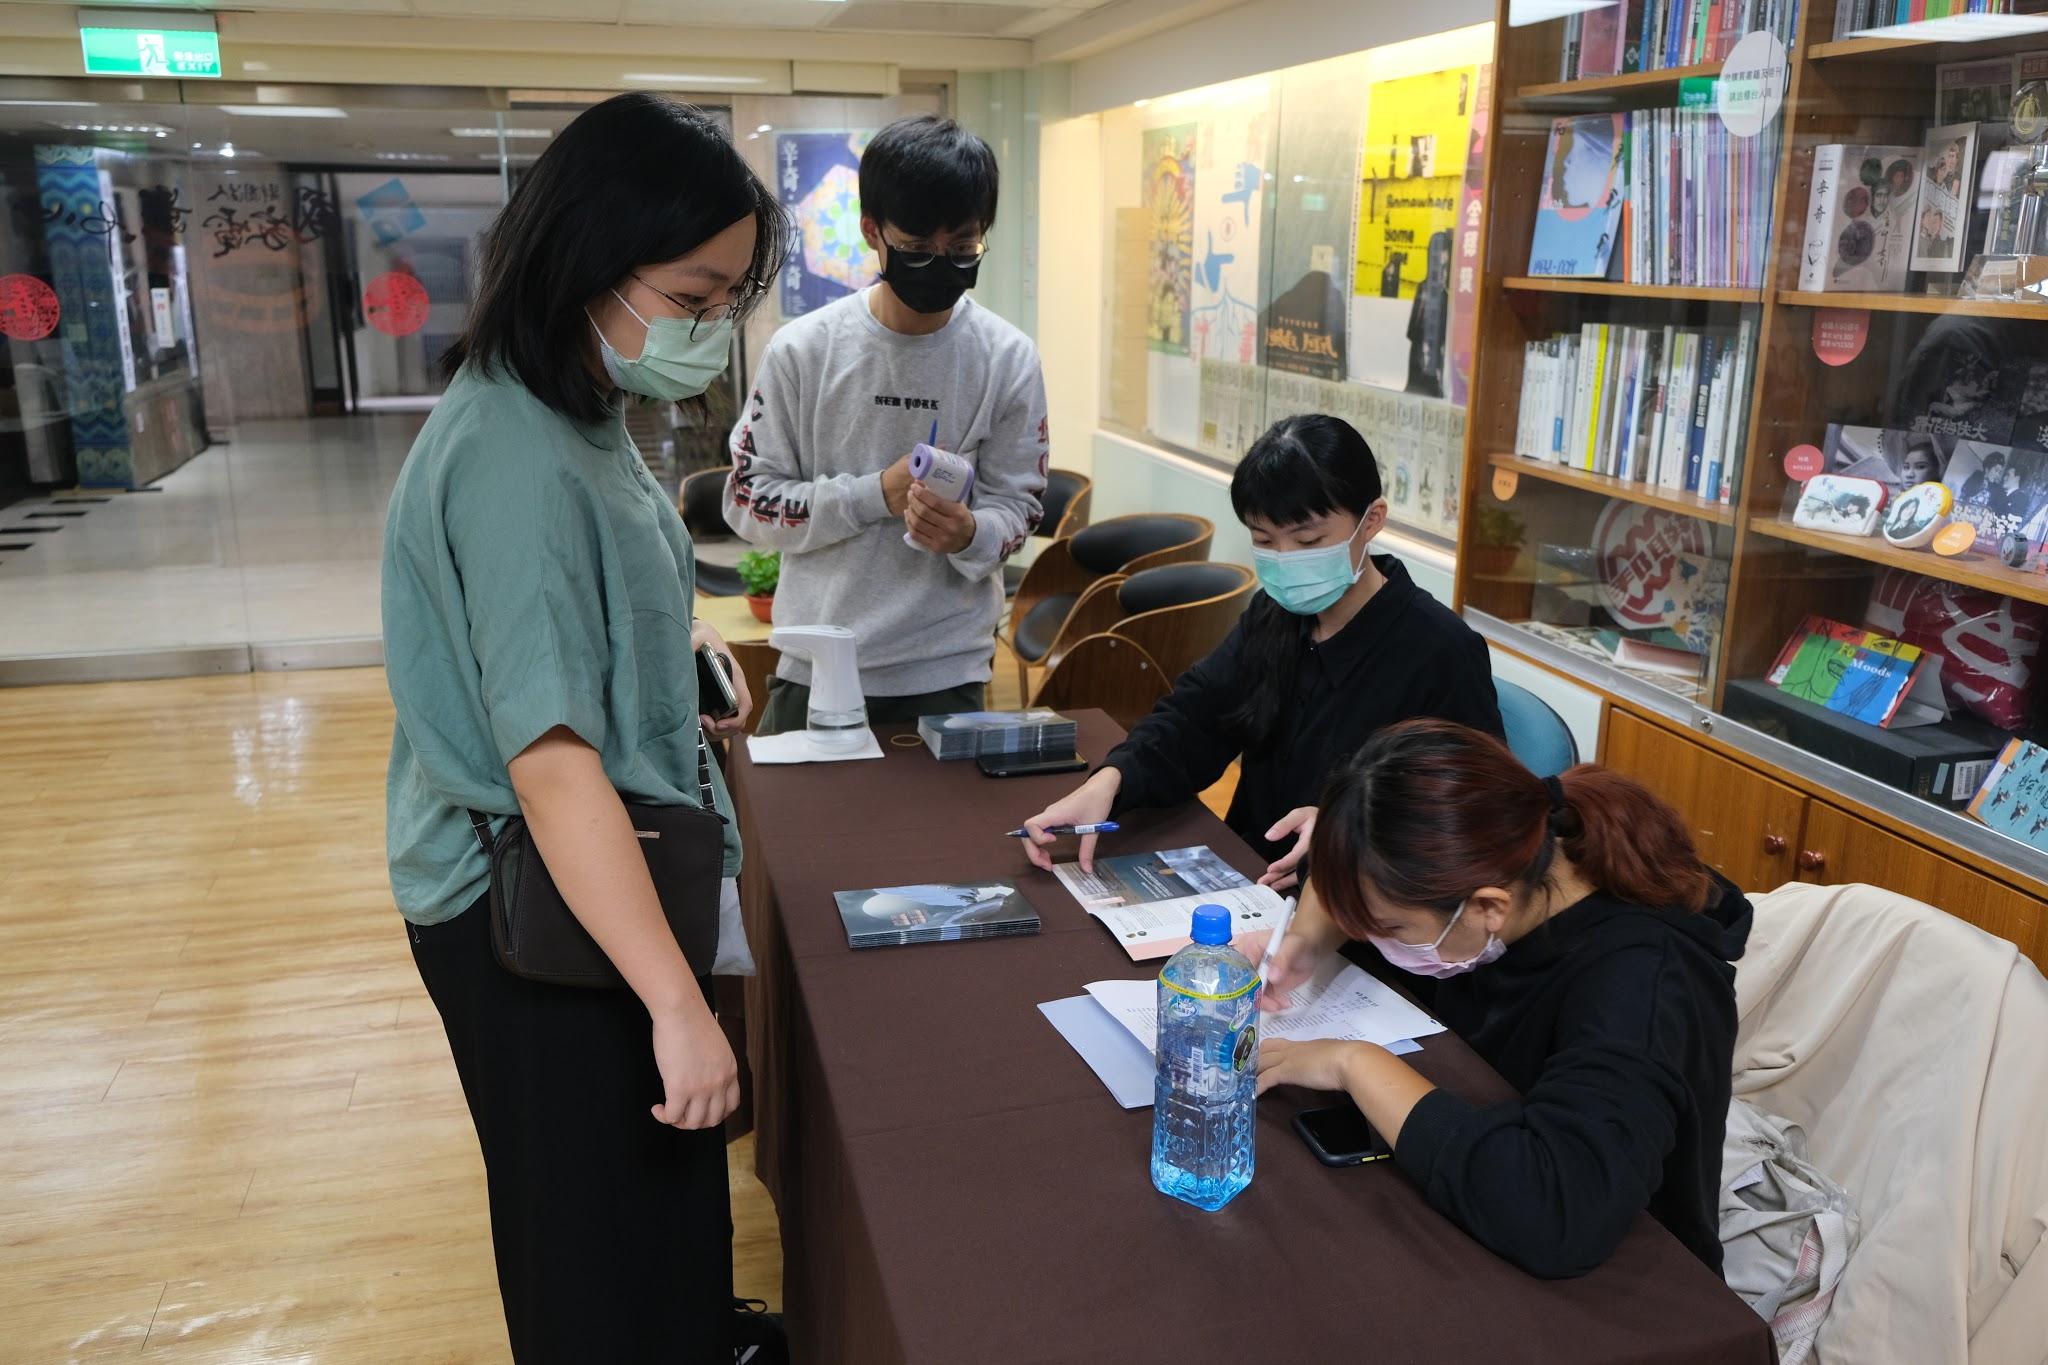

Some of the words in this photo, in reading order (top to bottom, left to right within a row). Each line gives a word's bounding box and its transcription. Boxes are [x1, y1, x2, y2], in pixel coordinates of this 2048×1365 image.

[176, 62, 212, 72] EXIT
[875, 395, 901, 407] NEW
[904, 397, 940, 410] YORK
[1850, 658, 1893, 679] Moods
